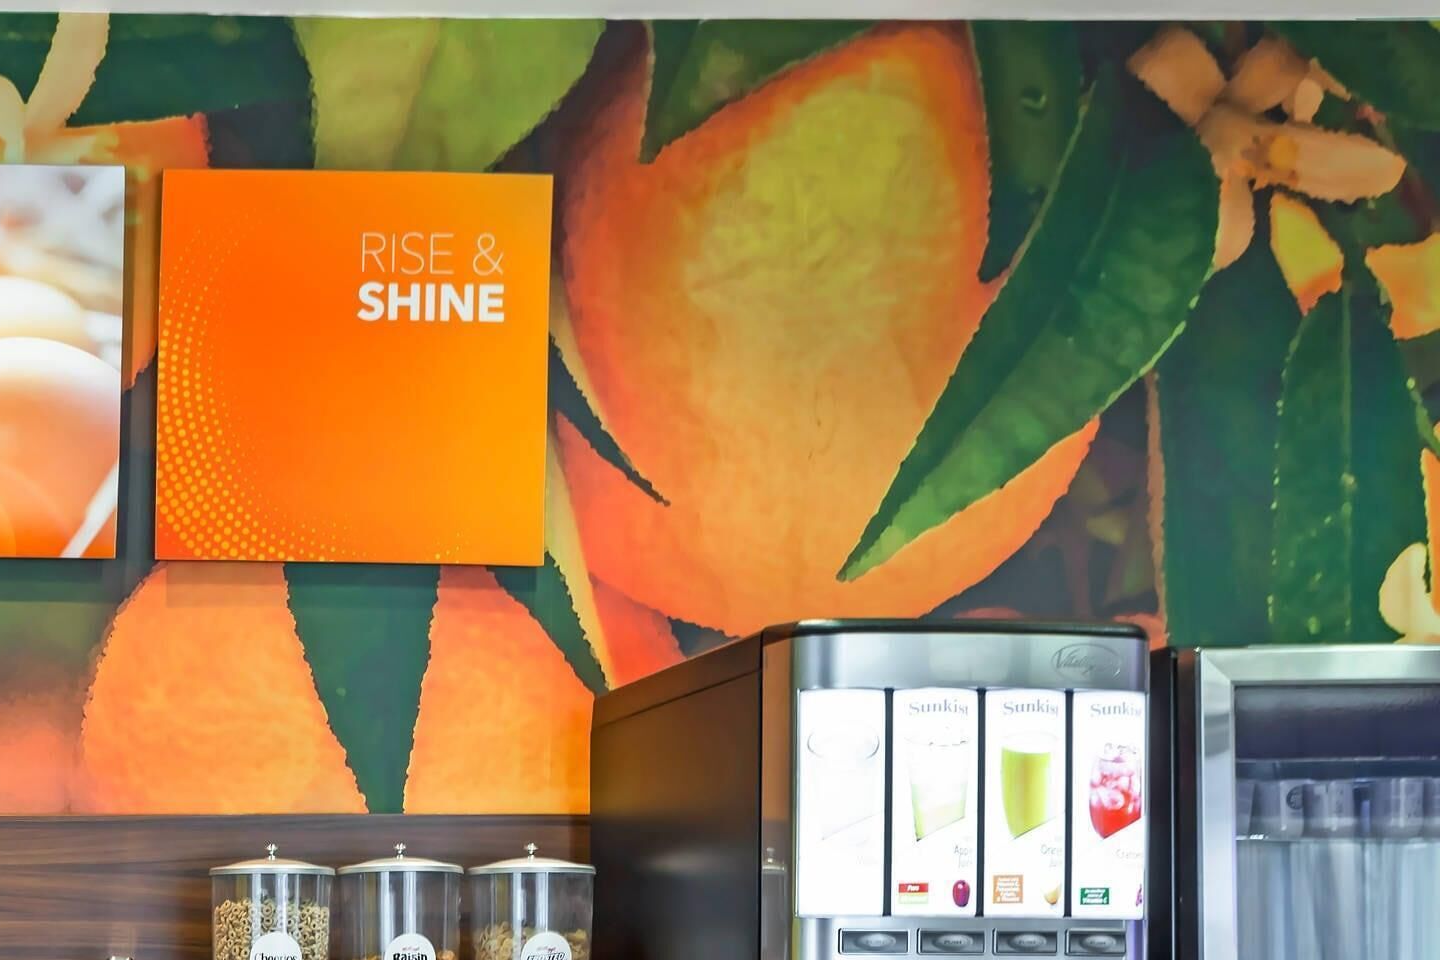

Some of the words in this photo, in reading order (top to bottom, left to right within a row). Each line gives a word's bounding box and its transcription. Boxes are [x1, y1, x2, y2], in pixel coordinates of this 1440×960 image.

[361, 232, 454, 275] RISE
[472, 232, 504, 276] &
[357, 281, 505, 322] SHINE
